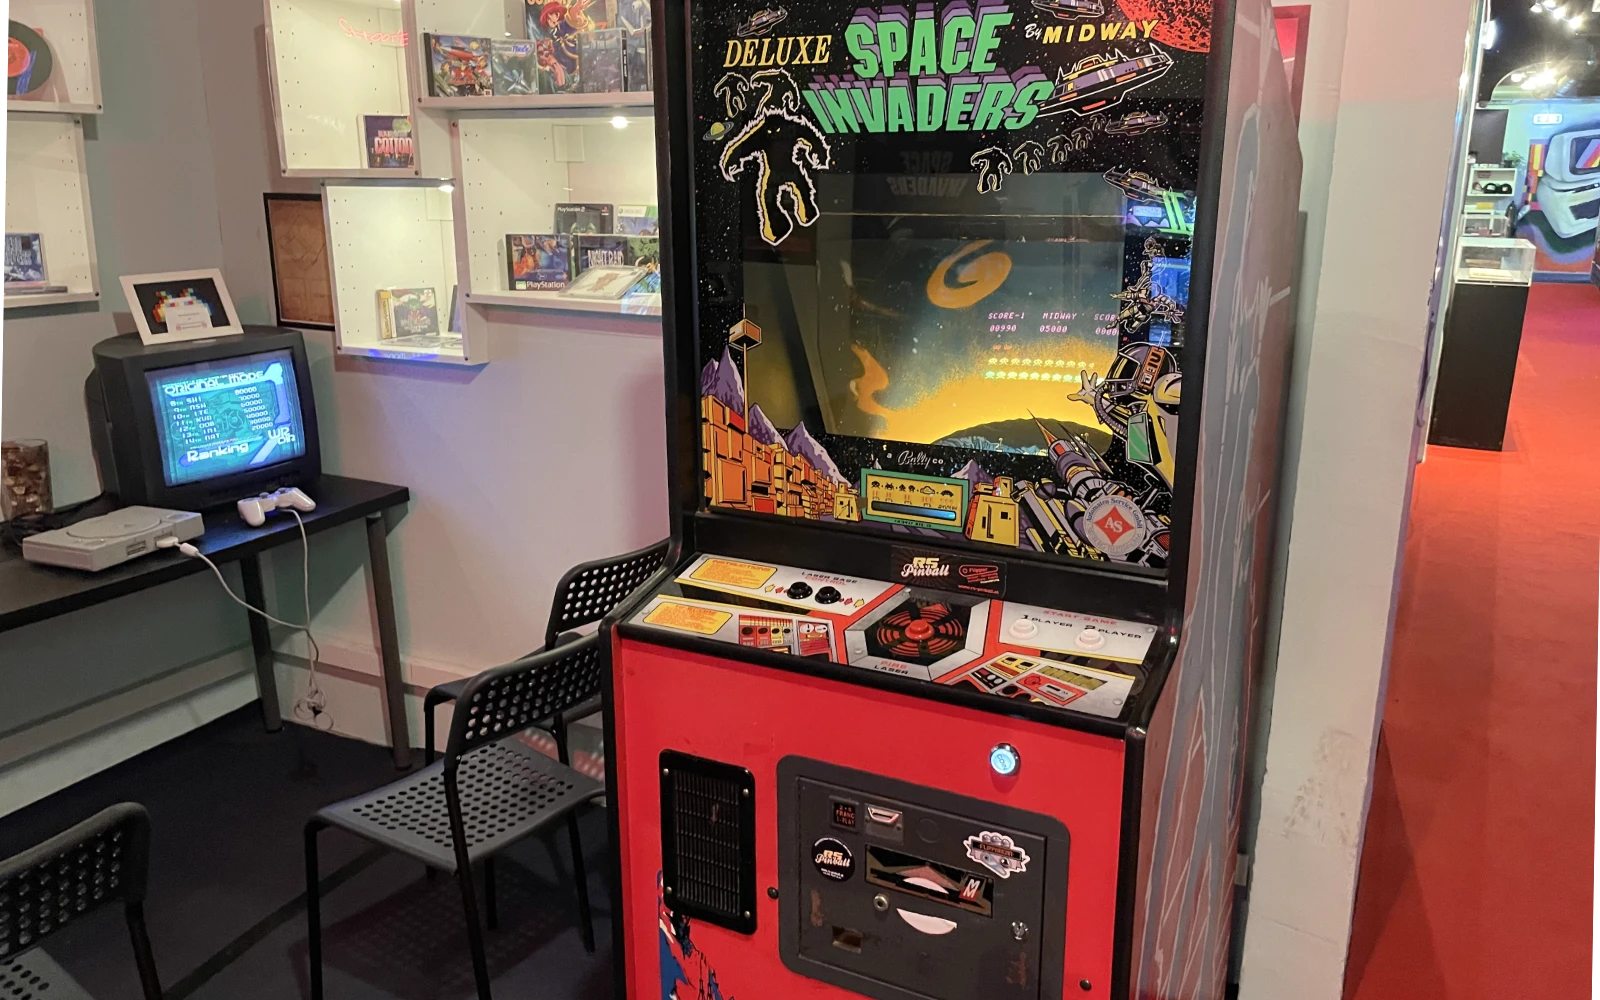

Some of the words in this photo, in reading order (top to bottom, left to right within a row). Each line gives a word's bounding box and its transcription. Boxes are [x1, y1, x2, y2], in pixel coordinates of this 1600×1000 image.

[1024, 22, 1043, 40] By
[1042, 19, 1158, 45] MIDWAY
[722, 35, 832, 68] DELUXE
[844, 11, 1014, 79] SPACE
[801, 79, 1056, 134] INVADERS
[526, 280, 565, 290] PlayStation
[988, 312, 1025, 320] SCORE-1
[1042, 312, 1077, 320] MIDWAY
[1093, 313, 1117, 321] SCOR
[989, 324, 1017, 332] 00990
[1039, 325, 1068, 333] 05000
[229, 371, 264, 384] MODE
[186, 442, 249, 462] Ranking
[897, 450, 931, 470] Bally
[1110, 497, 1133, 510] Service
[1104, 516, 1124, 533] AS
[912, 556, 940, 569] RS
[900, 563, 950, 578] Pinball
[801, 571, 830, 579] LASER
[833, 576, 858, 584] BASE
[804, 575, 846, 586] CONTROL
[1031, 617, 1073, 628] PLAYER
[1042, 609, 1080, 619] START
[1083, 616, 1117, 625] GAME
[1097, 628, 1142, 639] PLAYER
[873, 664, 909, 675] LASER
[880, 660, 908, 669] FIRE
[814, 853, 851, 868] Pinball
